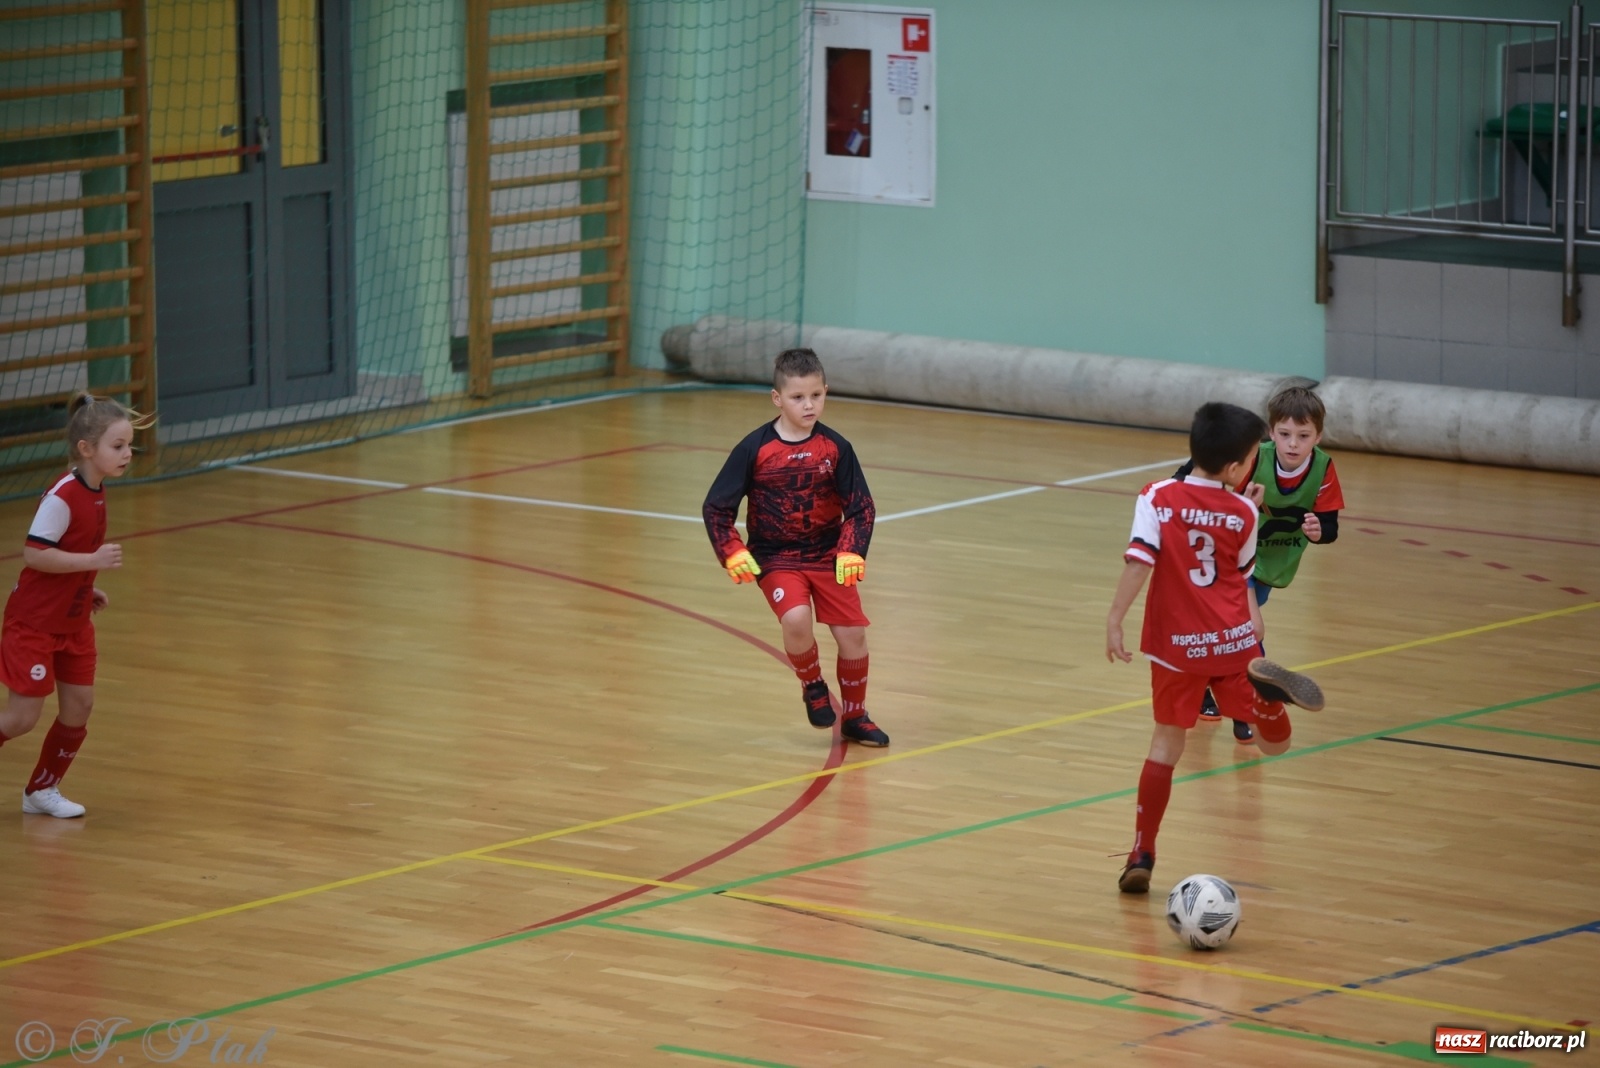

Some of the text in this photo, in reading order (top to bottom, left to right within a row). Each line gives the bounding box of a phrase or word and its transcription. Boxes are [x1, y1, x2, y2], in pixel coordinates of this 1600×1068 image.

[787, 451, 812, 460] regio
[1256, 536, 1302, 548] ATRICK
[1187, 528, 1219, 588] 3
